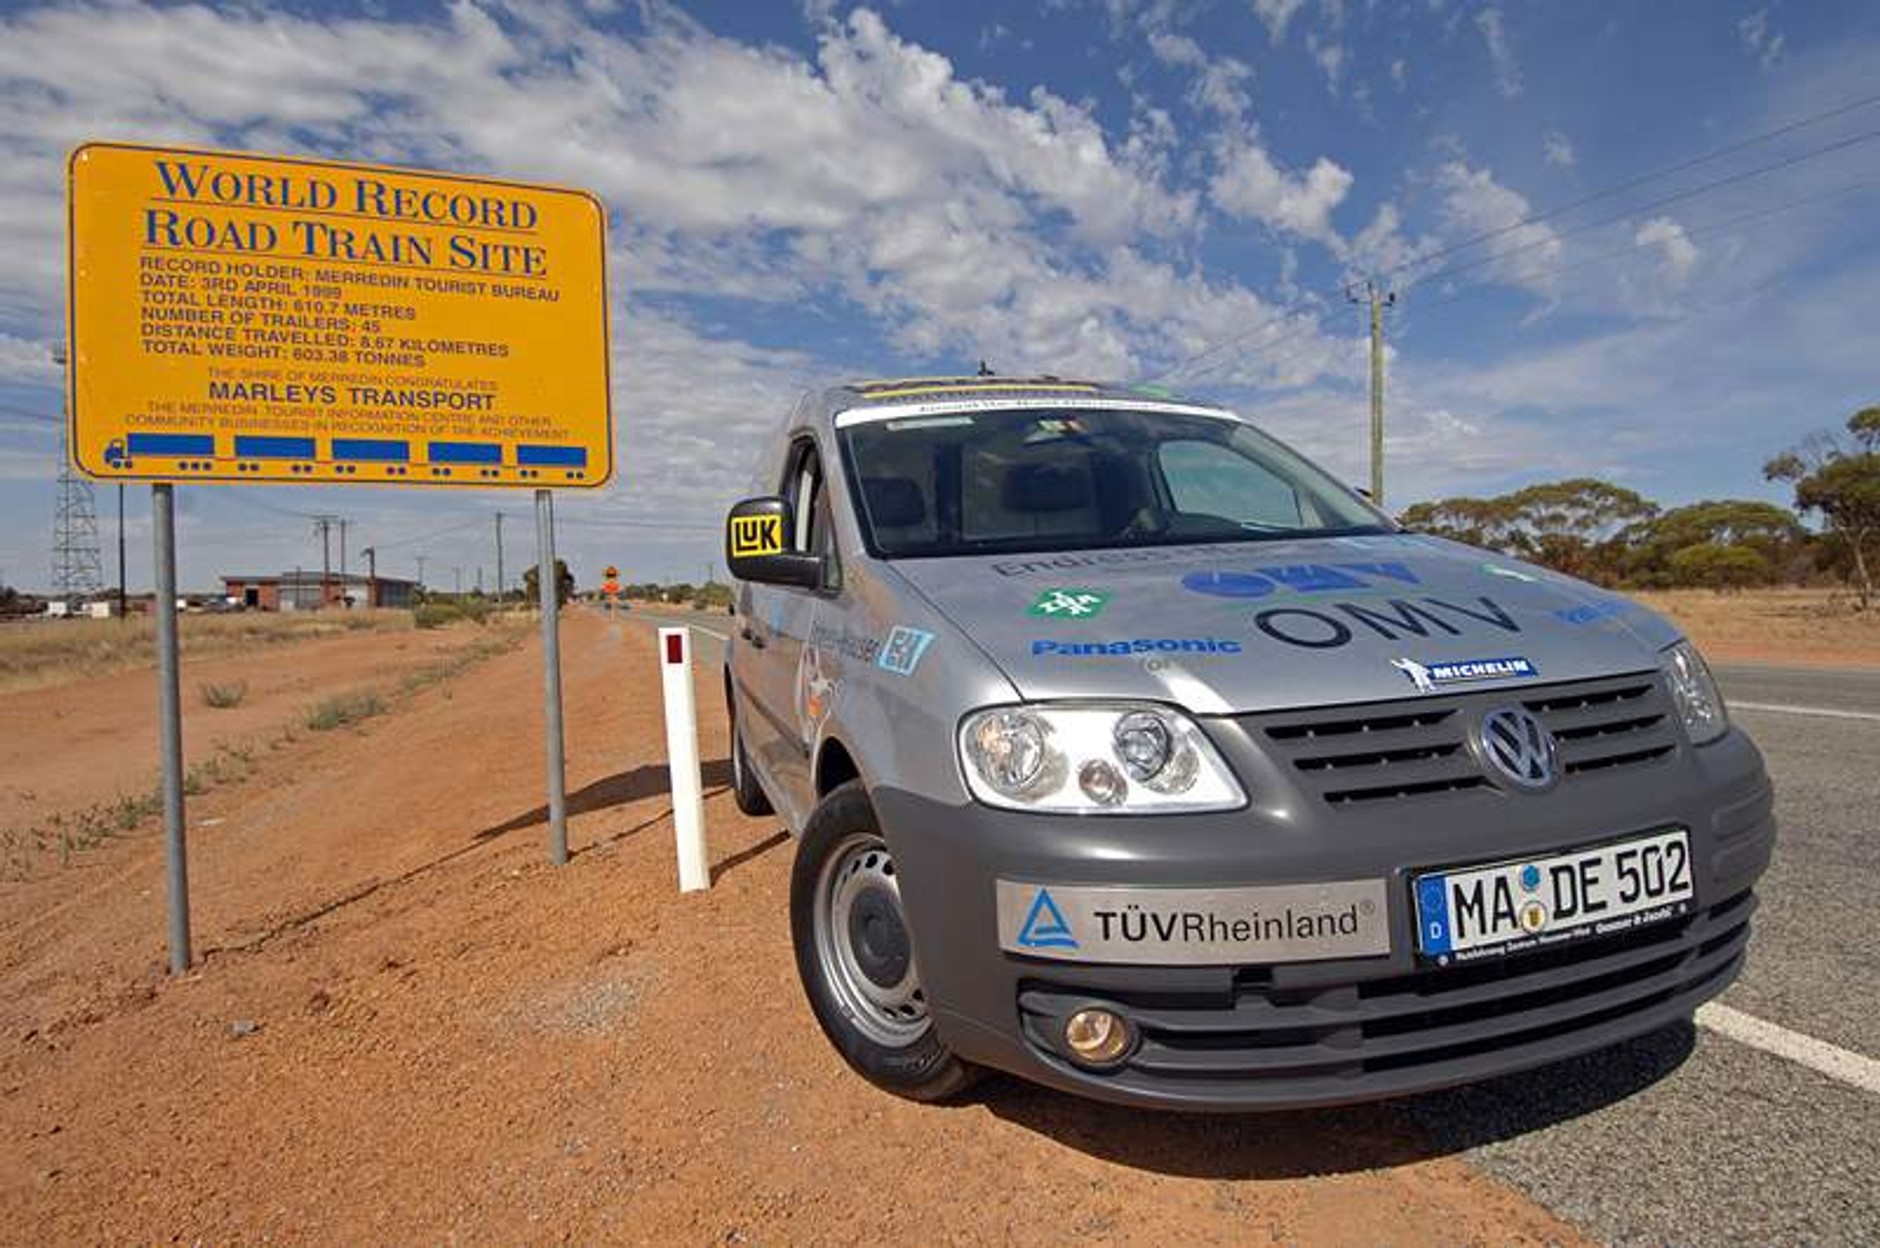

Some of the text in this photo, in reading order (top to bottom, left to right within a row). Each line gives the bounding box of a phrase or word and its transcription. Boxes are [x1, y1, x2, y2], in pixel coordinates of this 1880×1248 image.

[155, 161, 538, 229] WORLD RECORD
[145, 208, 547, 277] ROAD TRAIN SITE
[140, 256, 221, 275] RECORD
[315, 269, 408, 288] MERREDIN
[414, 277, 486, 295] TOURIST
[491, 282, 560, 302] BUREAU
[202, 277, 238, 292] 3RD
[142, 290, 200, 306] TOTAL
[344, 303, 416, 320] METRES
[142, 307, 225, 323] NUMBER
[230, 311, 255, 325] OF
[362, 320, 381, 334] 45
[141, 323, 237, 341] DISTANCE
[399, 338, 509, 358] KILOMETRES
[142, 339, 202, 356] TOTAL
[355, 351, 426, 368] TONNES
[209, 381, 497, 411] MARLEYS TRANSPORT
[1253, 596, 1522, 649] OMV
[1031, 638, 1242, 656] Panasonic
[1433, 660, 1529, 678] MICHELIN
[1453, 841, 1690, 939] MA DE 502
[1429, 921, 1442, 939] D
